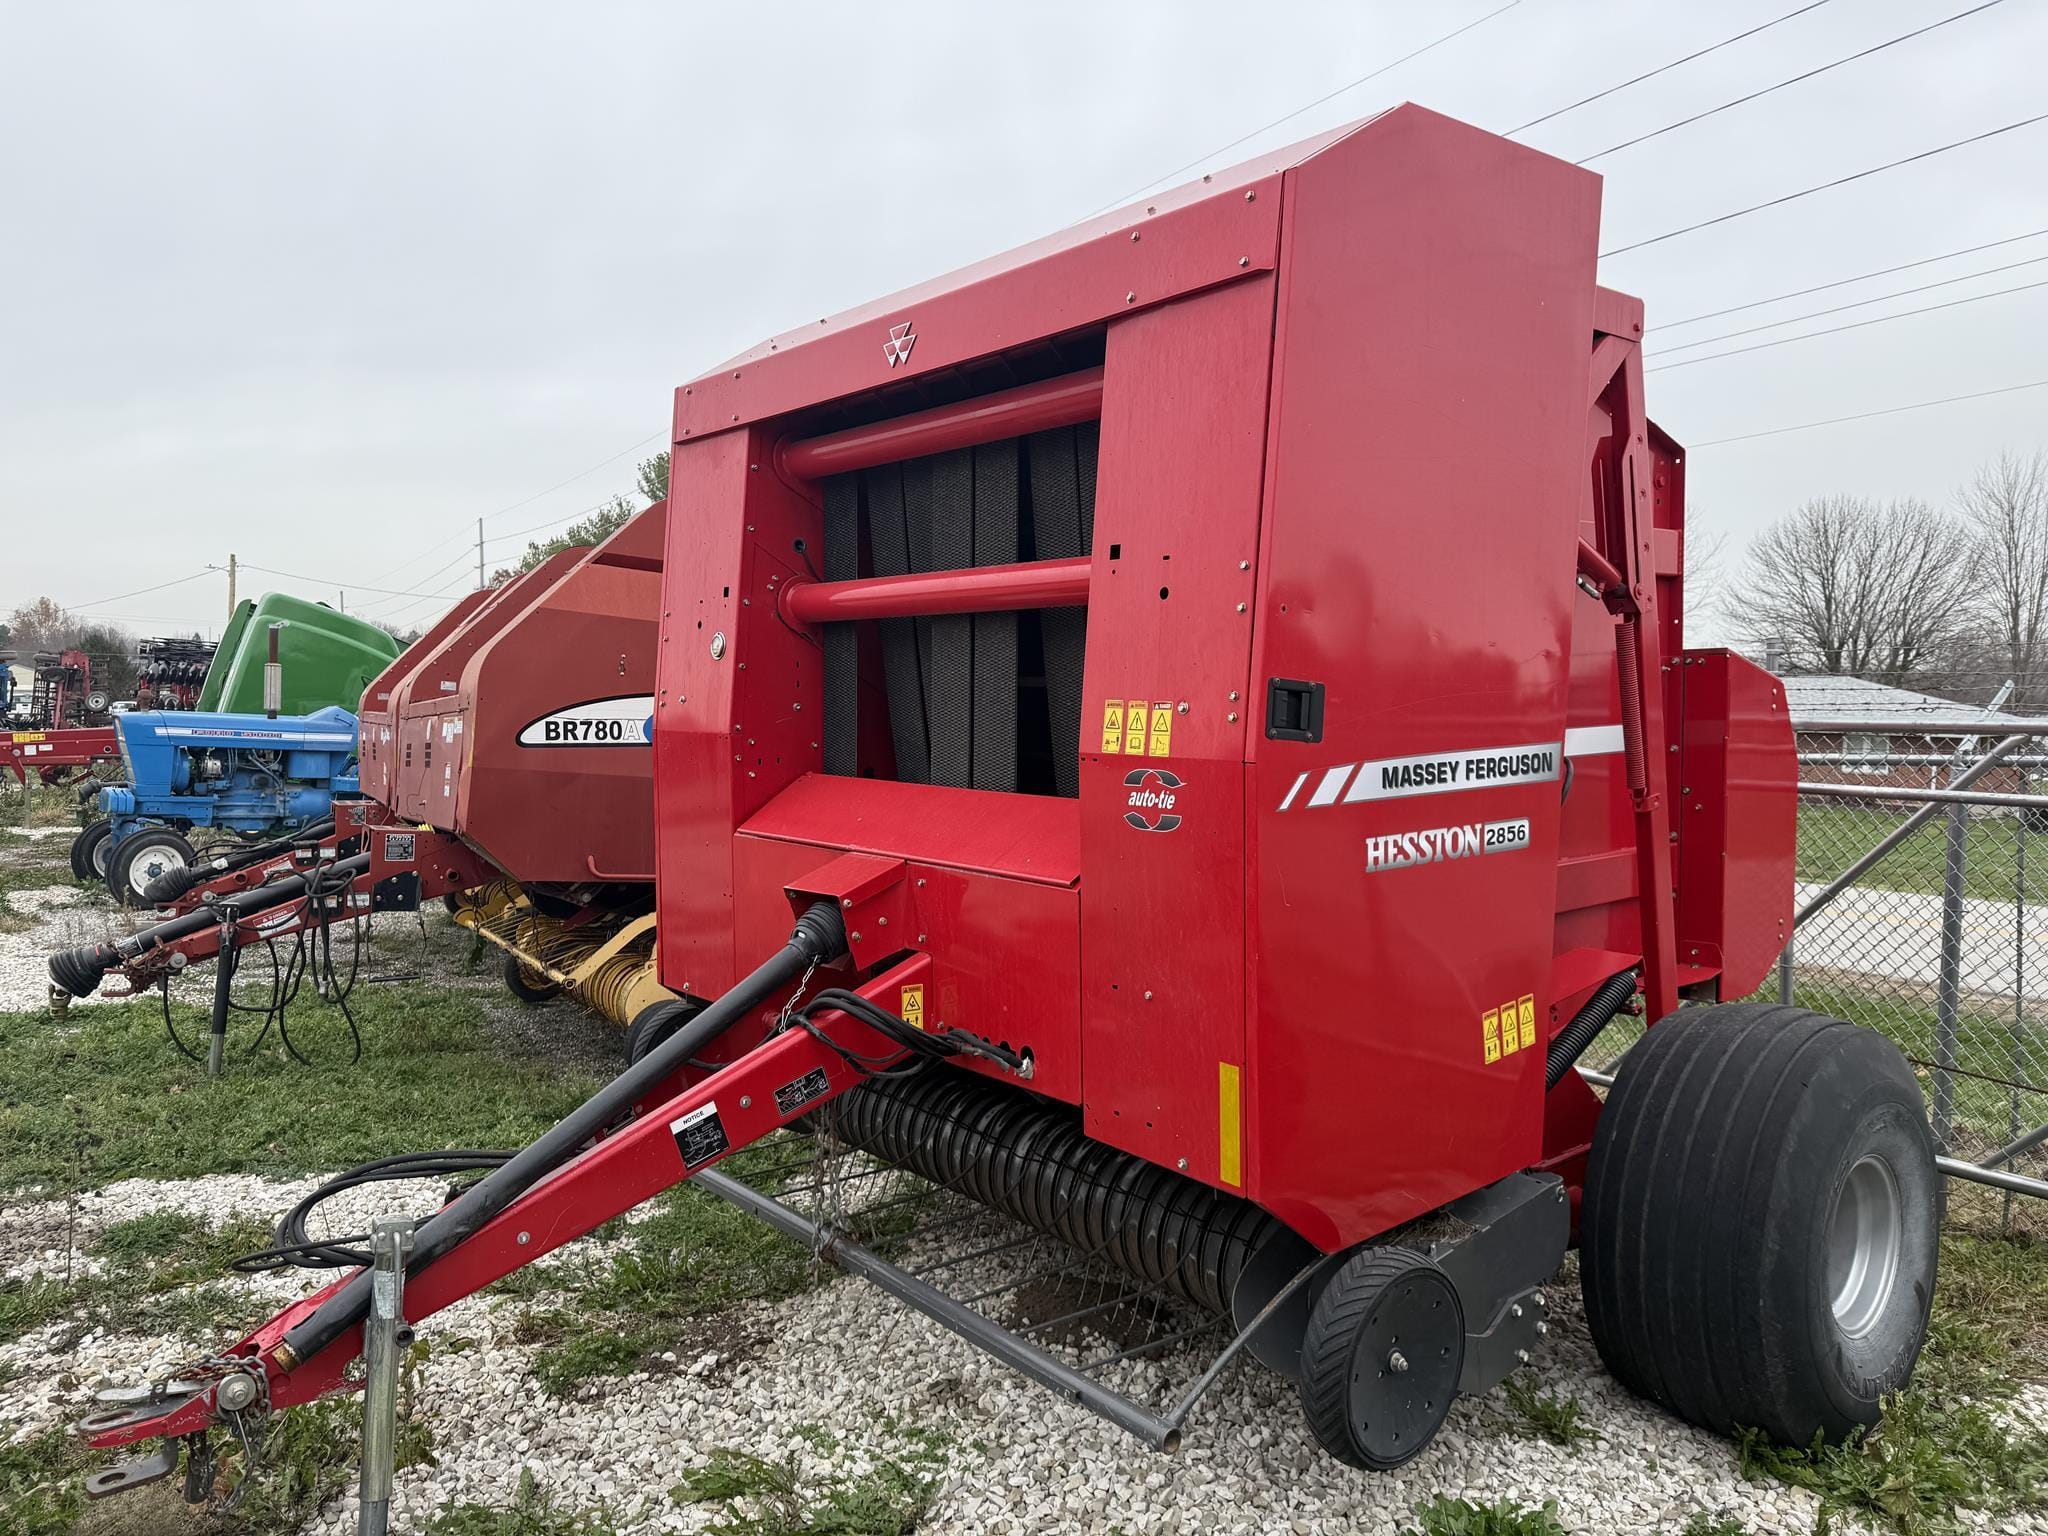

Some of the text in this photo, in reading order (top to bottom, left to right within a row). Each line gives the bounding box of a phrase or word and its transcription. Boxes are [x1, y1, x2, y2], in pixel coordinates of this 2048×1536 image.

[545, 720, 640, 741] BR780A
[1382, 752, 1553, 789] MASSEY FERGUSON
[1128, 789, 1175, 809] auto-tie
[1365, 823, 1526, 873] HESSTON 2856
[683, 1110, 705, 1126] NOTICE
